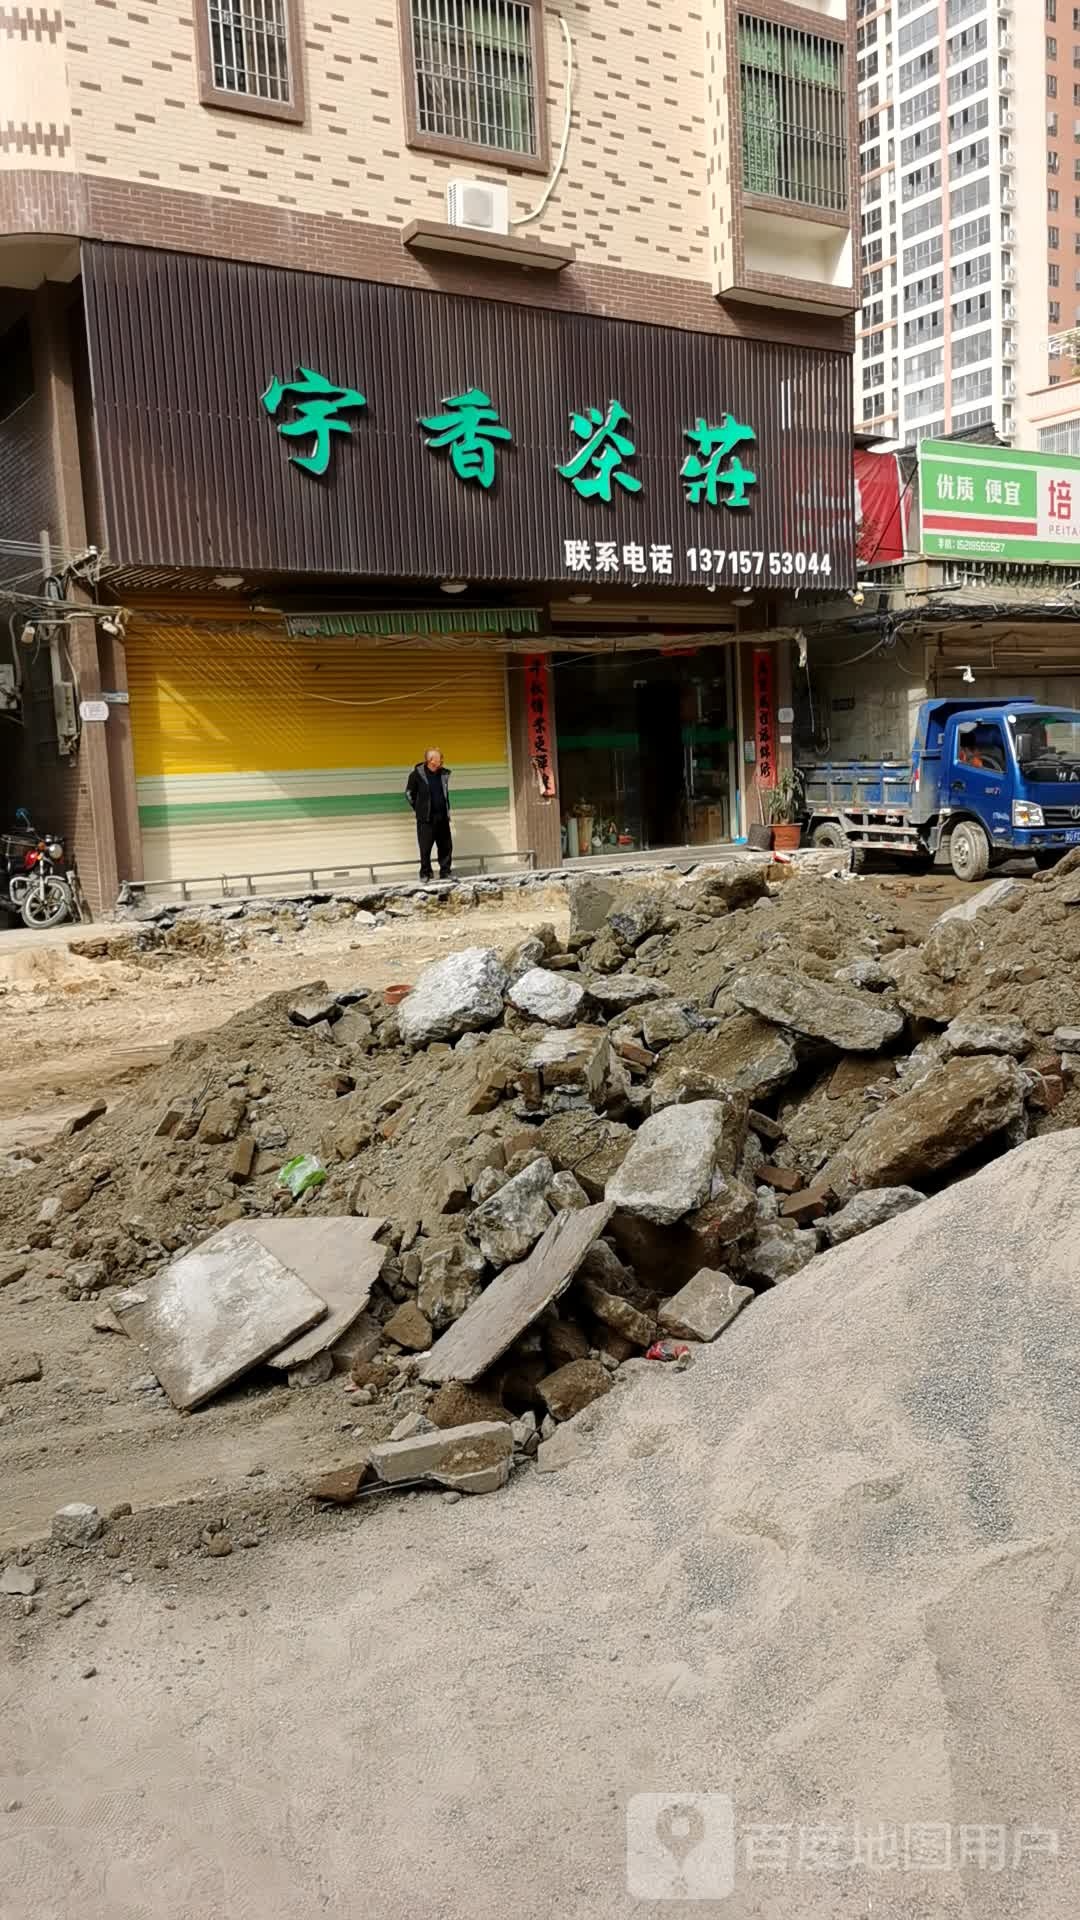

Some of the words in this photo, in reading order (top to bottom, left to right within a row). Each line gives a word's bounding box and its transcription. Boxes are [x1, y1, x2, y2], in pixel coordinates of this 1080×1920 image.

[260, 365, 758, 508] 宇香茶莊
[936, 473, 975, 502] 优质
[985, 479, 1022, 506] 便宜
[1048, 480, 1072, 520] 培
[1048, 524, 1080, 537] PEITA
[564, 540, 673, 574] 联系电话
[687, 548, 832, 576] 13715753044
